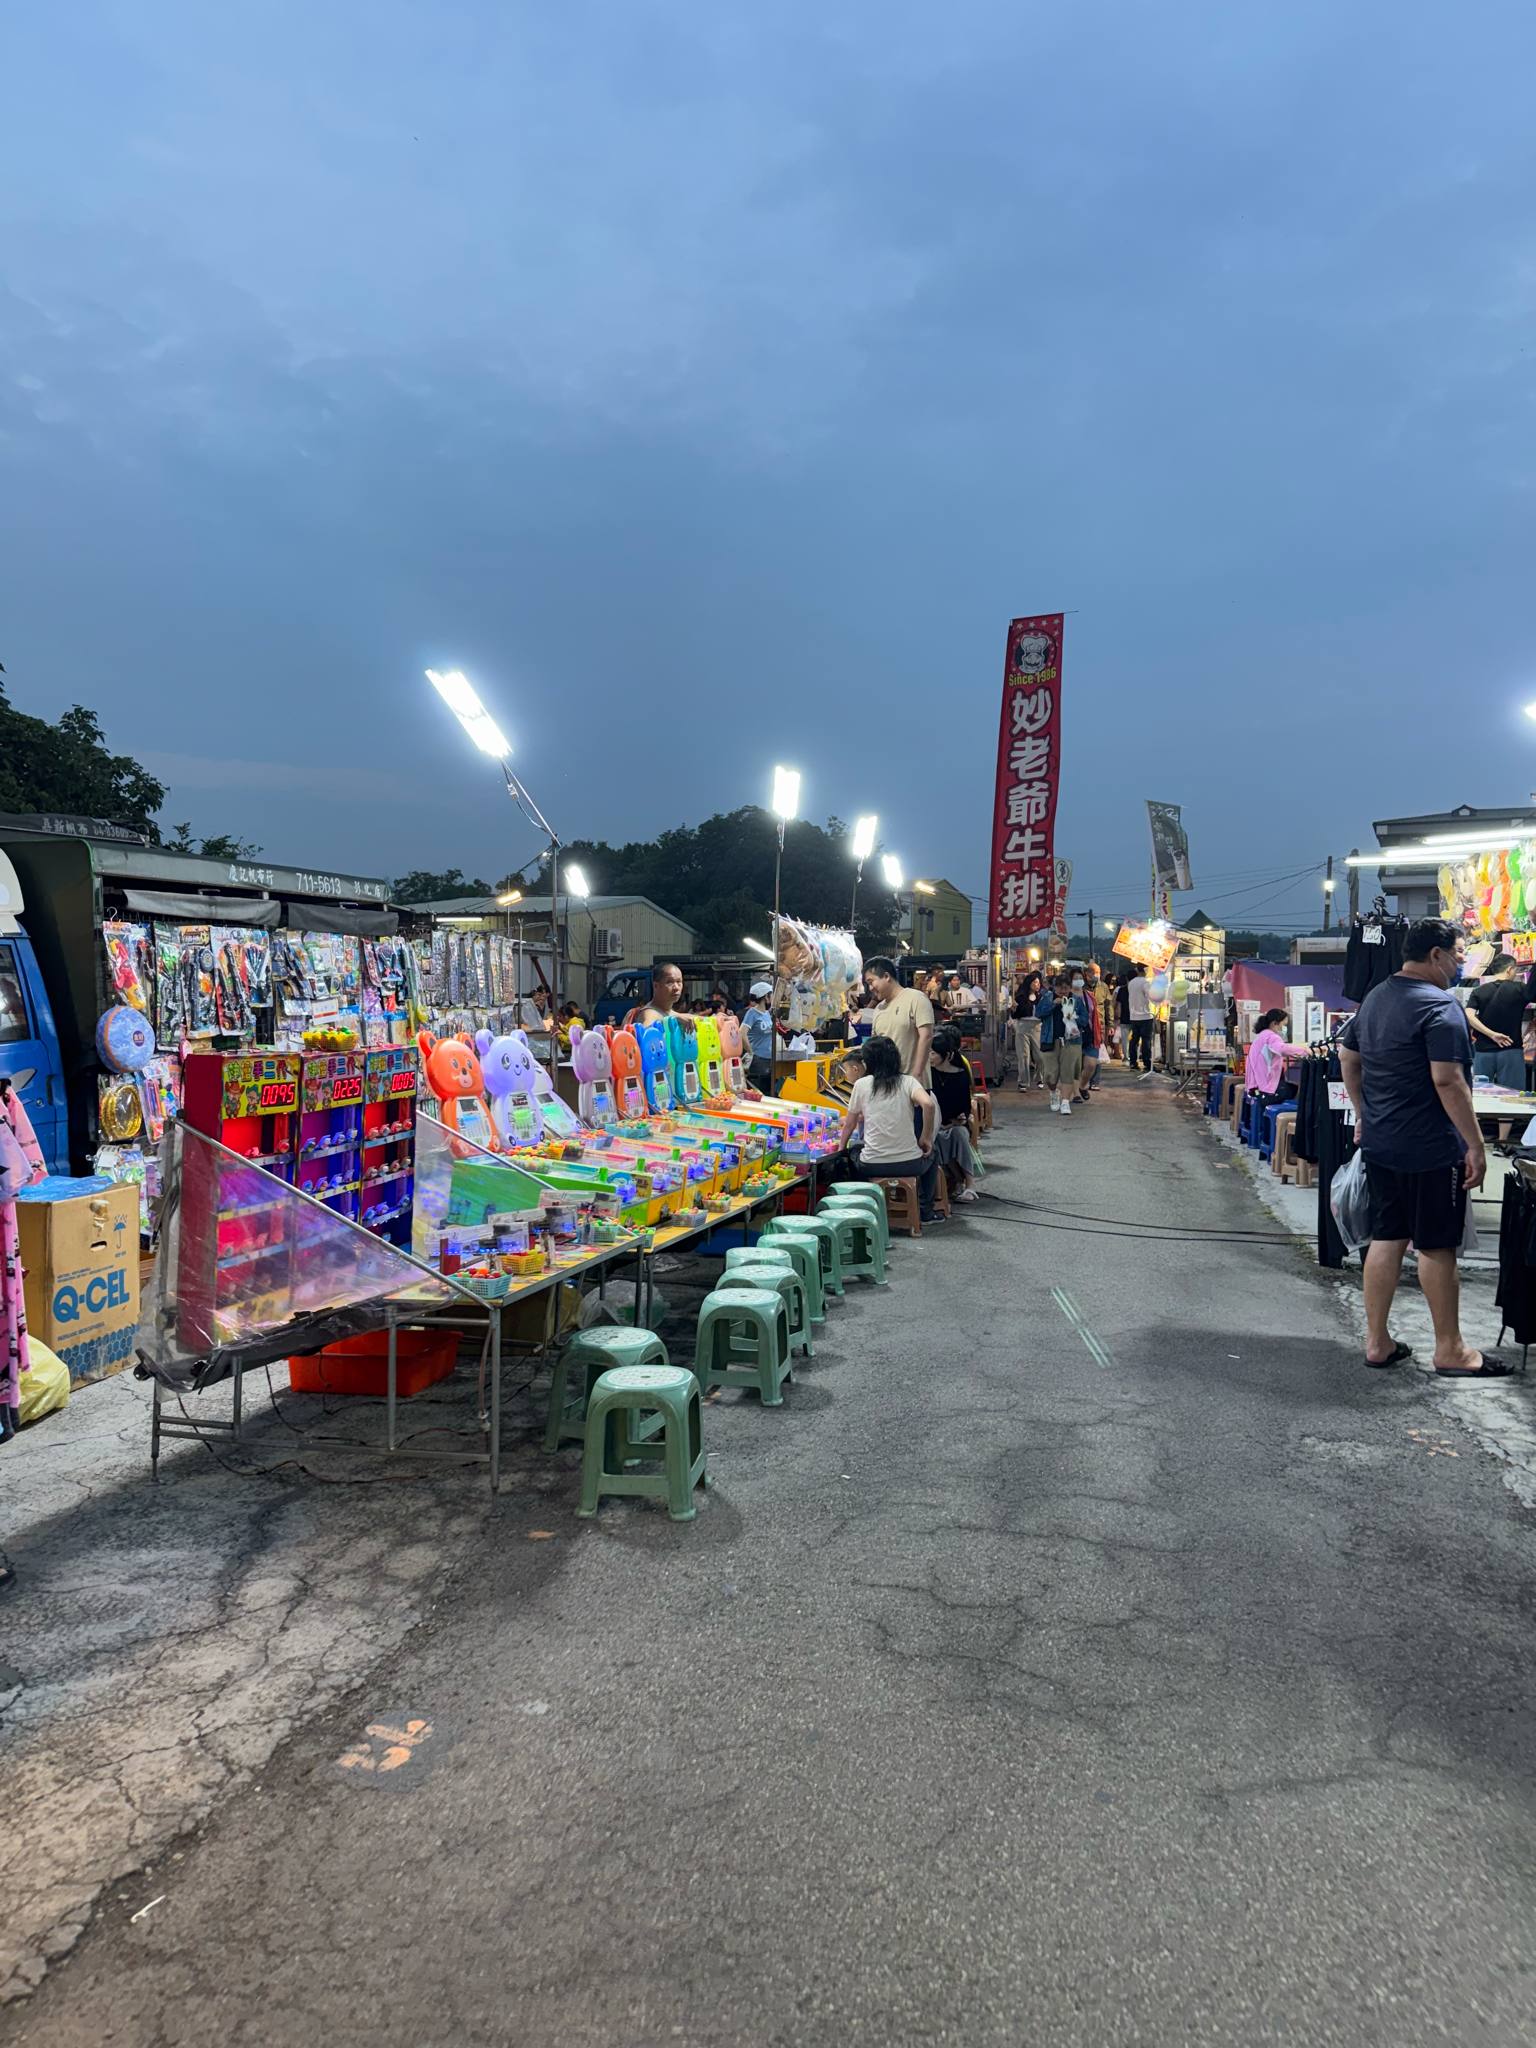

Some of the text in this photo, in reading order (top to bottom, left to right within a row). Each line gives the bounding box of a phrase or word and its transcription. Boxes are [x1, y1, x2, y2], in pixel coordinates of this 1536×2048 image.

[1008, 667, 1056, 687] Since 1986
[1002, 688, 1053, 919] 妙老爺牛排
[296, 872, 342, 895] 711-5613
[261, 1084, 295, 1106] 0095
[333, 1078, 361, 1100] 0225
[53, 1268, 130, 1324] Q-CEL
